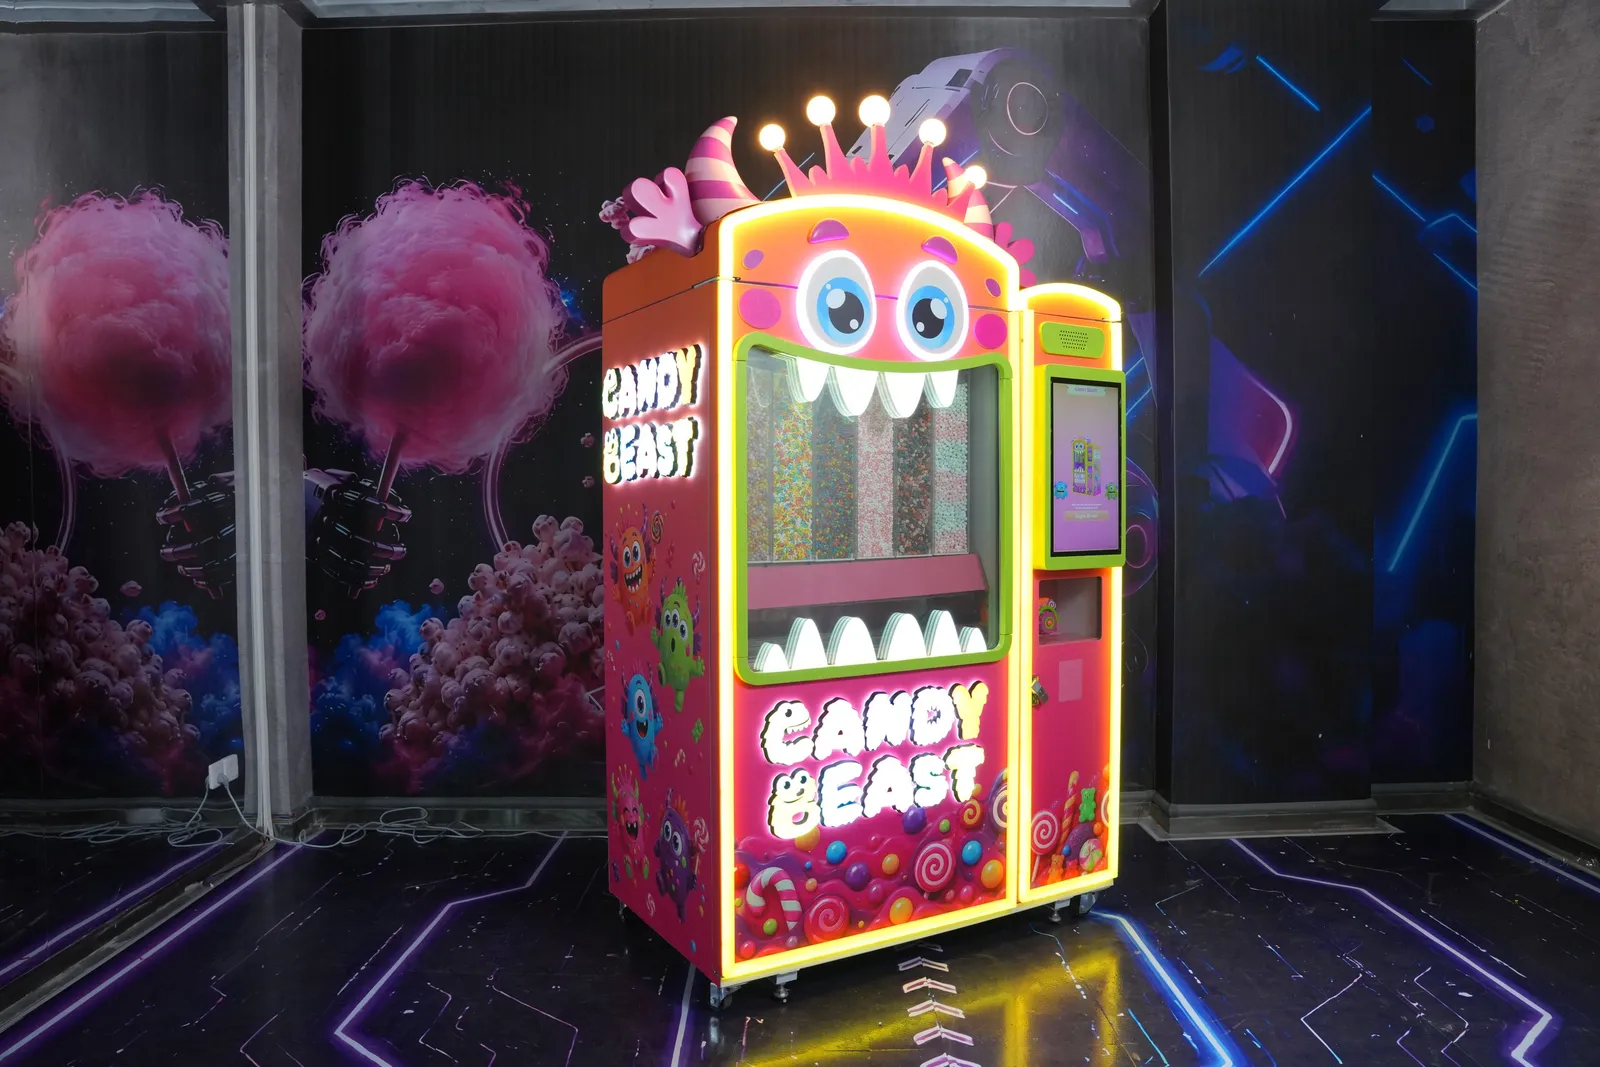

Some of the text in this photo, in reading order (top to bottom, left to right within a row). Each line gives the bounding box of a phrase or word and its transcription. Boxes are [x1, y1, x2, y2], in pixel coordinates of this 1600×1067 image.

[602, 344, 702, 420] CANDY
[603, 416, 699, 485] BEAST
[760, 680, 989, 766] CANDY
[768, 743, 985, 840] BEAST
